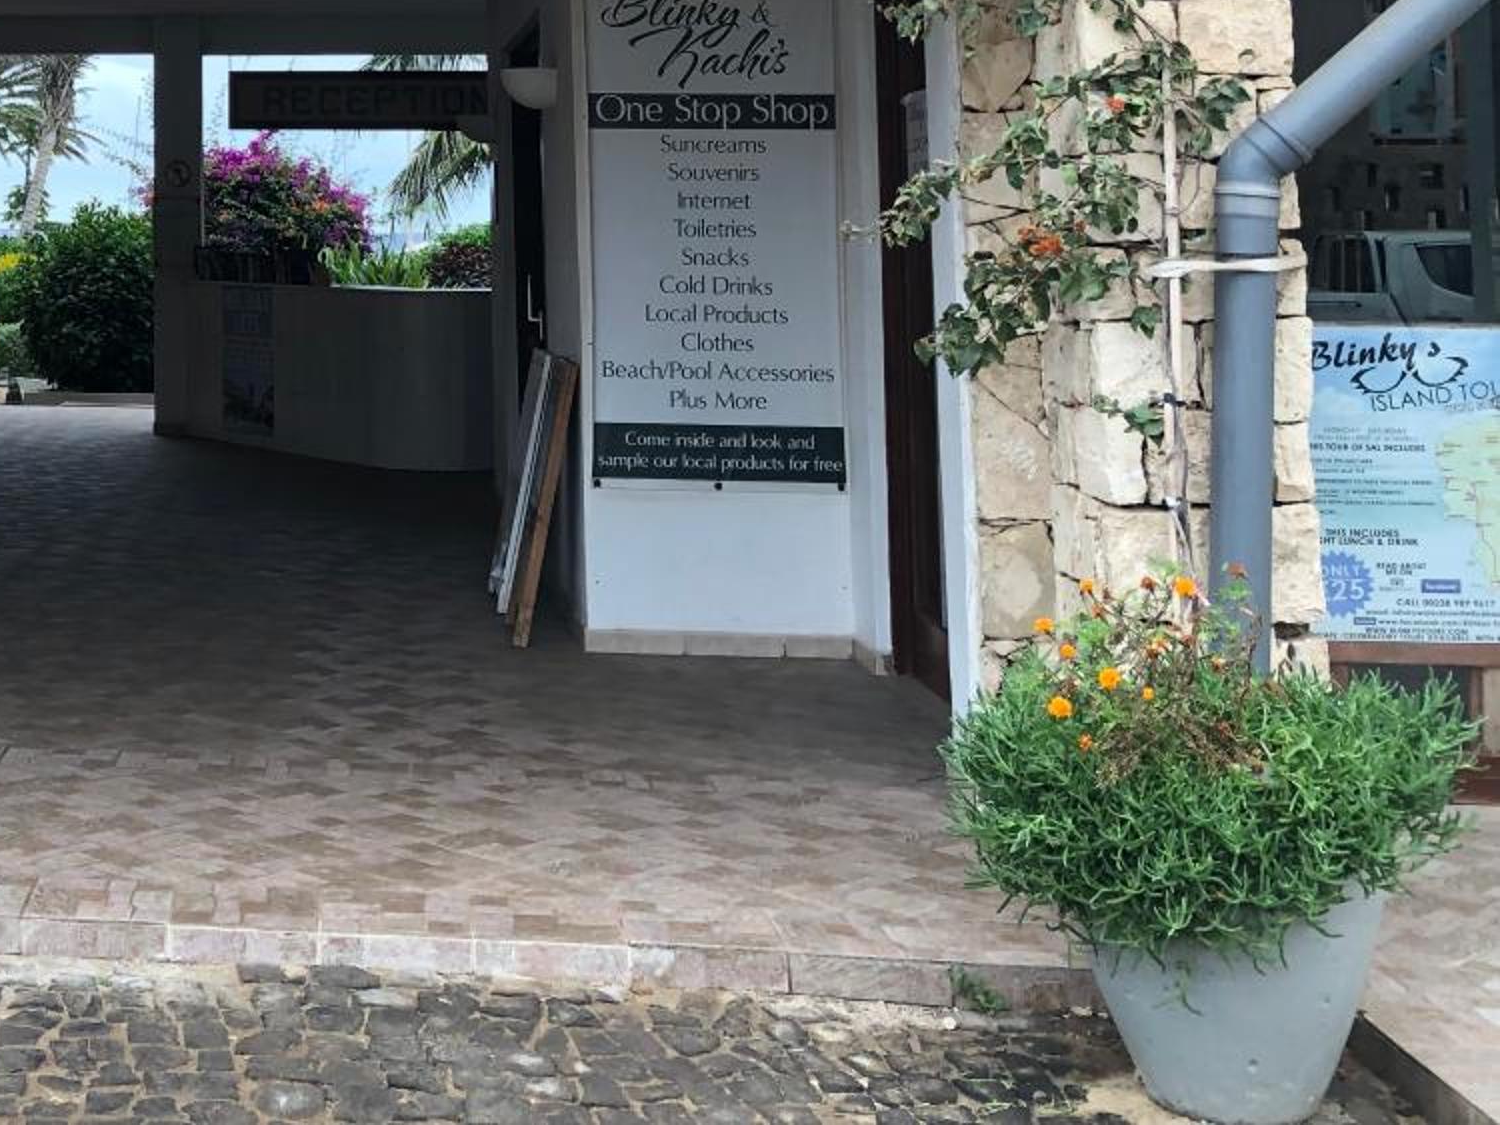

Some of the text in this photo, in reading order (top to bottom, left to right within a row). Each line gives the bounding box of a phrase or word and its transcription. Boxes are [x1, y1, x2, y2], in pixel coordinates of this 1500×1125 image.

[751, 0, 775, 26] &
[629, 27, 791, 89] Kachi's
[263, 84, 488, 116] RECEPTION
[595, 94, 829, 131] One Stop Shop
[660, 134, 767, 155] Suncreams
[667, 162, 760, 182] Souvenirs
[676, 191, 750, 211] Internet
[674, 218, 757, 239] Toiletries
[681, 247, 750, 268] Snacks
[659, 275, 773, 297] Cold Drinks
[645, 303, 789, 325] Local Products
[680, 331, 755, 353] Clothes
[601, 359, 835, 383] Beach/Pool Accessories
[669, 388, 768, 411] Plus More
[1371, 387, 1453, 413] ISLAND
[625, 432, 815, 450] Come inside and look and
[598, 453, 843, 473] sample our local products for free
